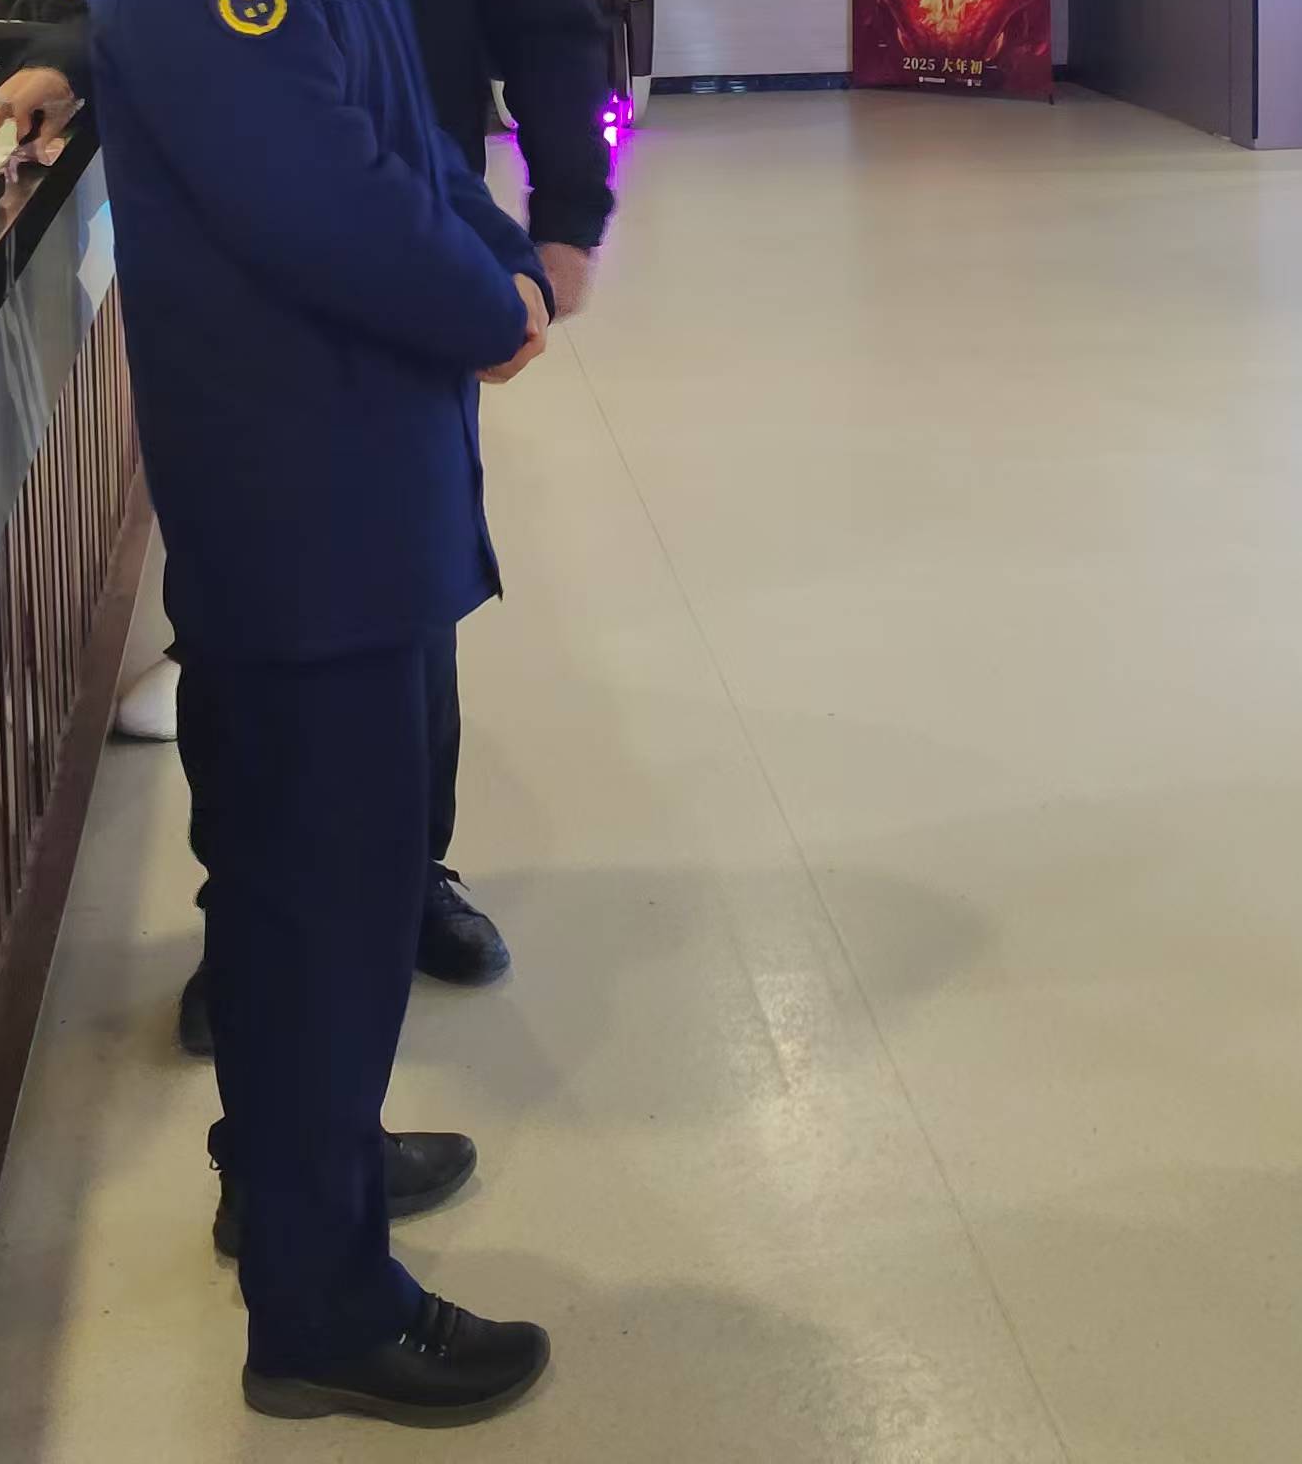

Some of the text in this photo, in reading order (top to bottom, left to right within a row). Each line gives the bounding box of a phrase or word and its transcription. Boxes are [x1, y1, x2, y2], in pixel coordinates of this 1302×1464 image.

[903, 57, 998, 75] 2025 大年初一
